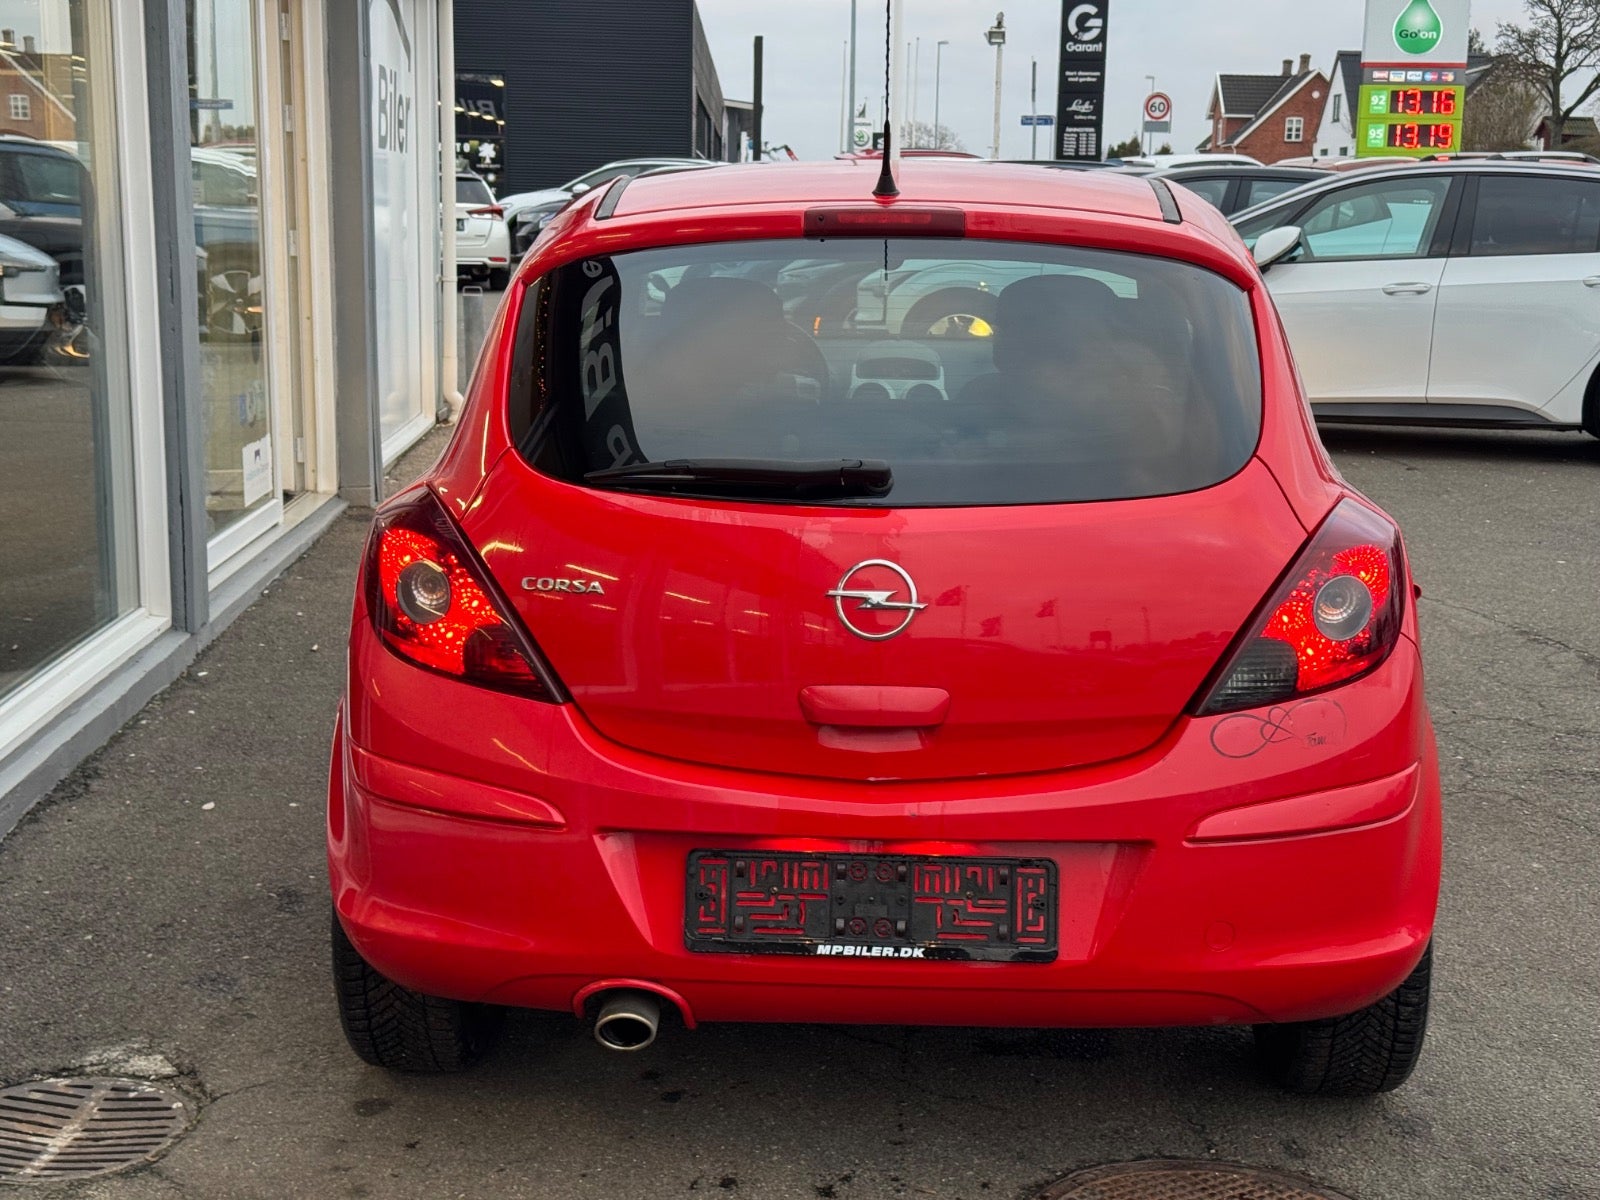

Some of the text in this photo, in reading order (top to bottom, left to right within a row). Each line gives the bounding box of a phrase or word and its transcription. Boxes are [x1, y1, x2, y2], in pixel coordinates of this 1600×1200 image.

[1399, 29, 1437, 39] Go'on
[1066, 42, 1102, 53] Garant
[378, 64, 411, 154] Biler
[1149, 102, 1166, 112] 60
[1371, 89, 1455, 114] 92 13.16
[1369, 123, 1453, 148] 95 13.19
[521, 577, 605, 595] CORSA
[816, 945, 925, 958] MPBILER.DK
